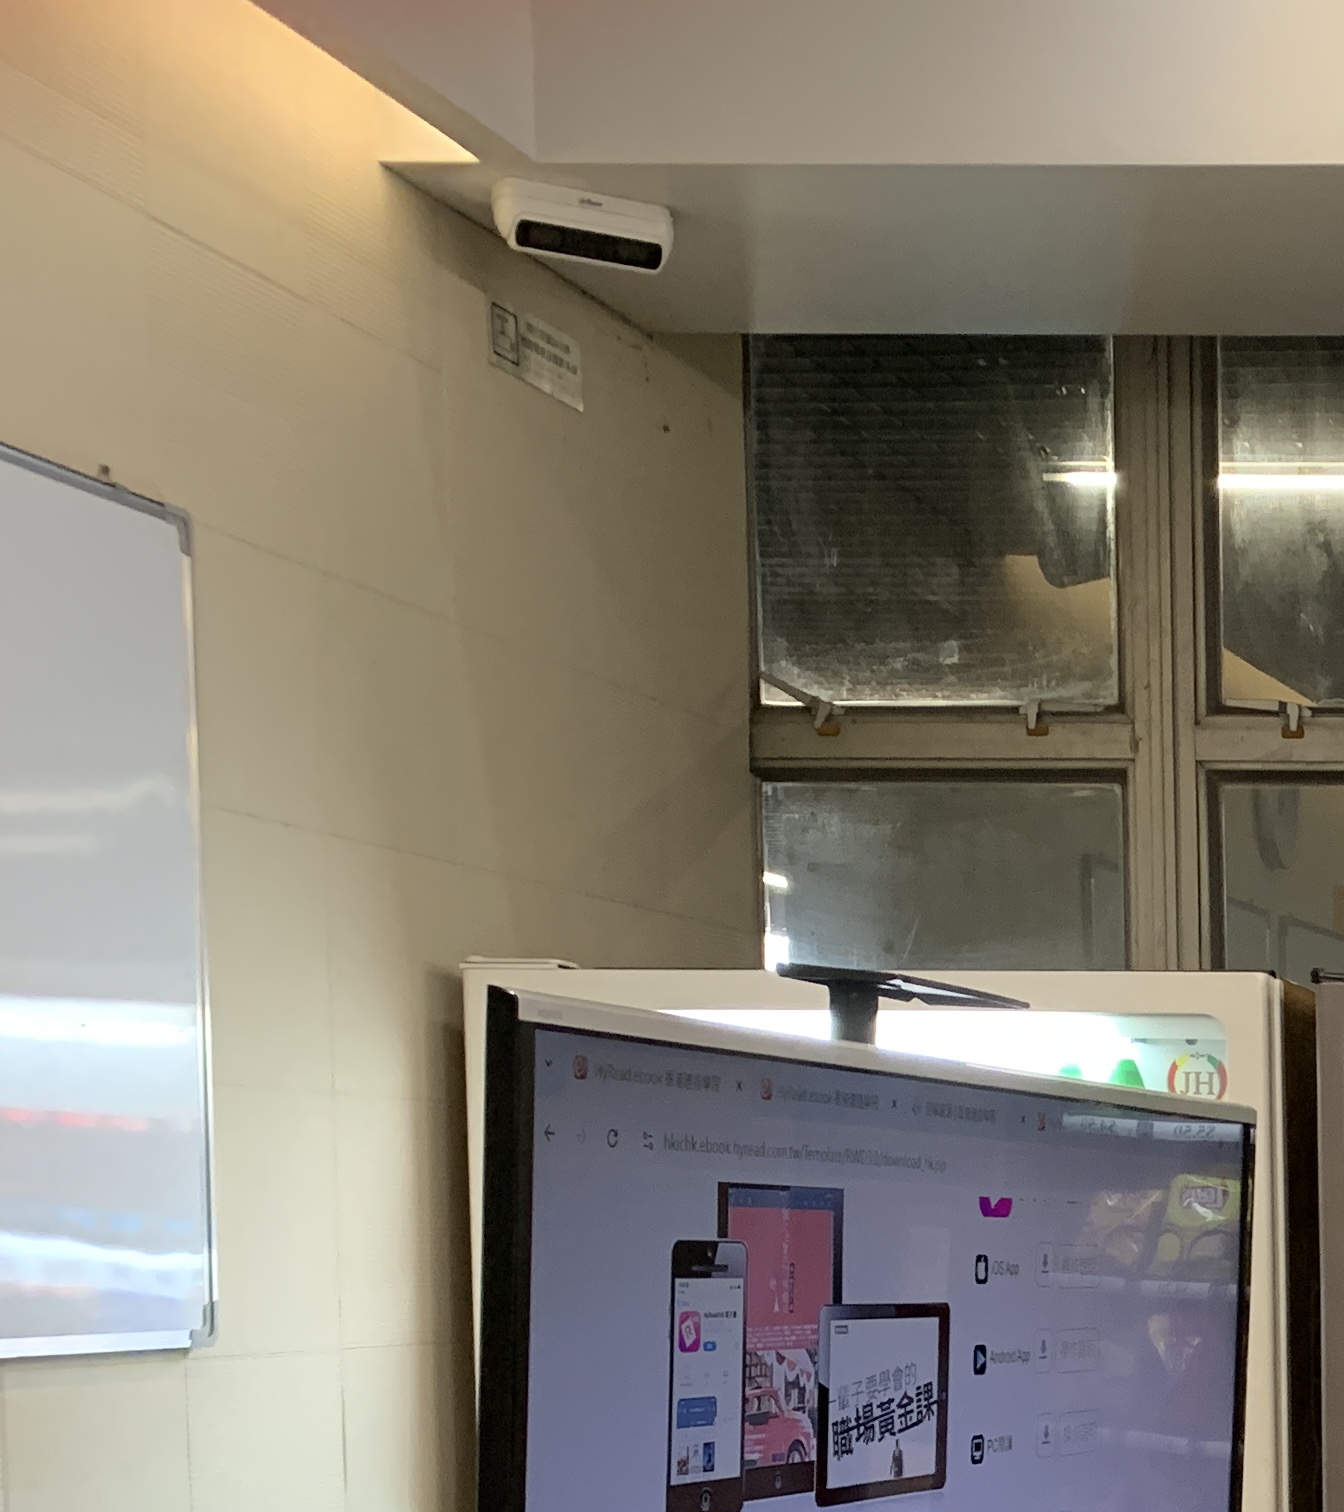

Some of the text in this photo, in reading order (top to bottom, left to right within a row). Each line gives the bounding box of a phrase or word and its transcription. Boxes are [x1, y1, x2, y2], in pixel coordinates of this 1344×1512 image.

[1179, 1070, 1216, 1096] JH
[832, 1381, 939, 1461] 職場黃金課
